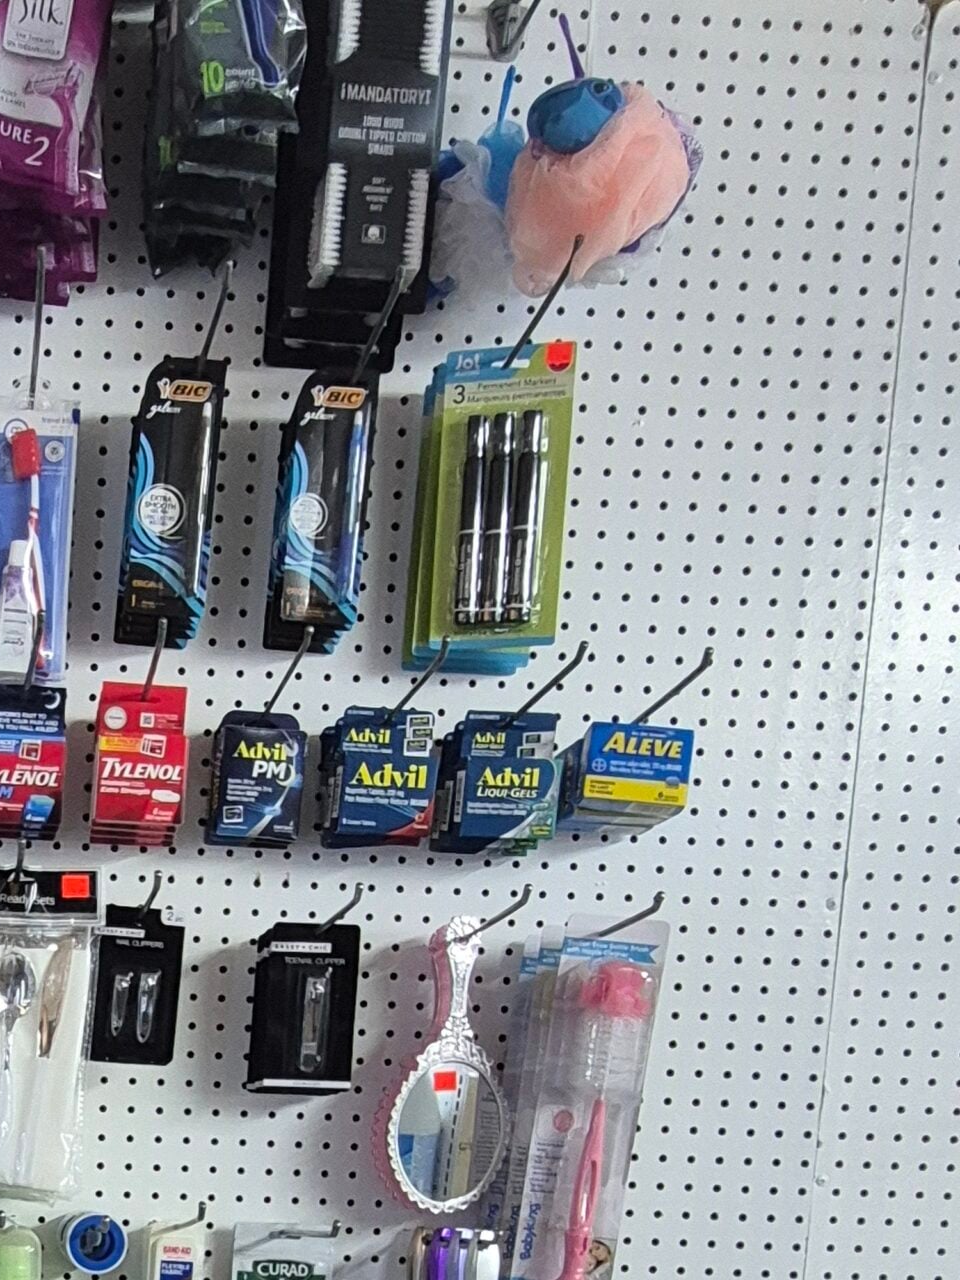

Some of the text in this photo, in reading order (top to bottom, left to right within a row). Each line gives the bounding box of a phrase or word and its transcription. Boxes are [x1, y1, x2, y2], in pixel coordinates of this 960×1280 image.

[200, 60, 225, 97] 10
[24, 136, 50, 166] 2
[173, 383, 209, 398] BIC
[327, 391, 361, 404] BIC
[452, 384, 466, 404] 3
[345, 727, 391, 743] Advil
[474, 731, 506, 744] Advil
[602, 731, 684, 758] ALEVE
[232, 740, 287, 761] Advil
[100, 757, 182, 781] TYLENOL
[252, 760, 288, 779] PM
[348, 761, 428, 789] Advil
[476, 766, 540, 787] Advil
[166, 912, 174, 922] 2
[257, 1262, 309, 1277] CURAD
